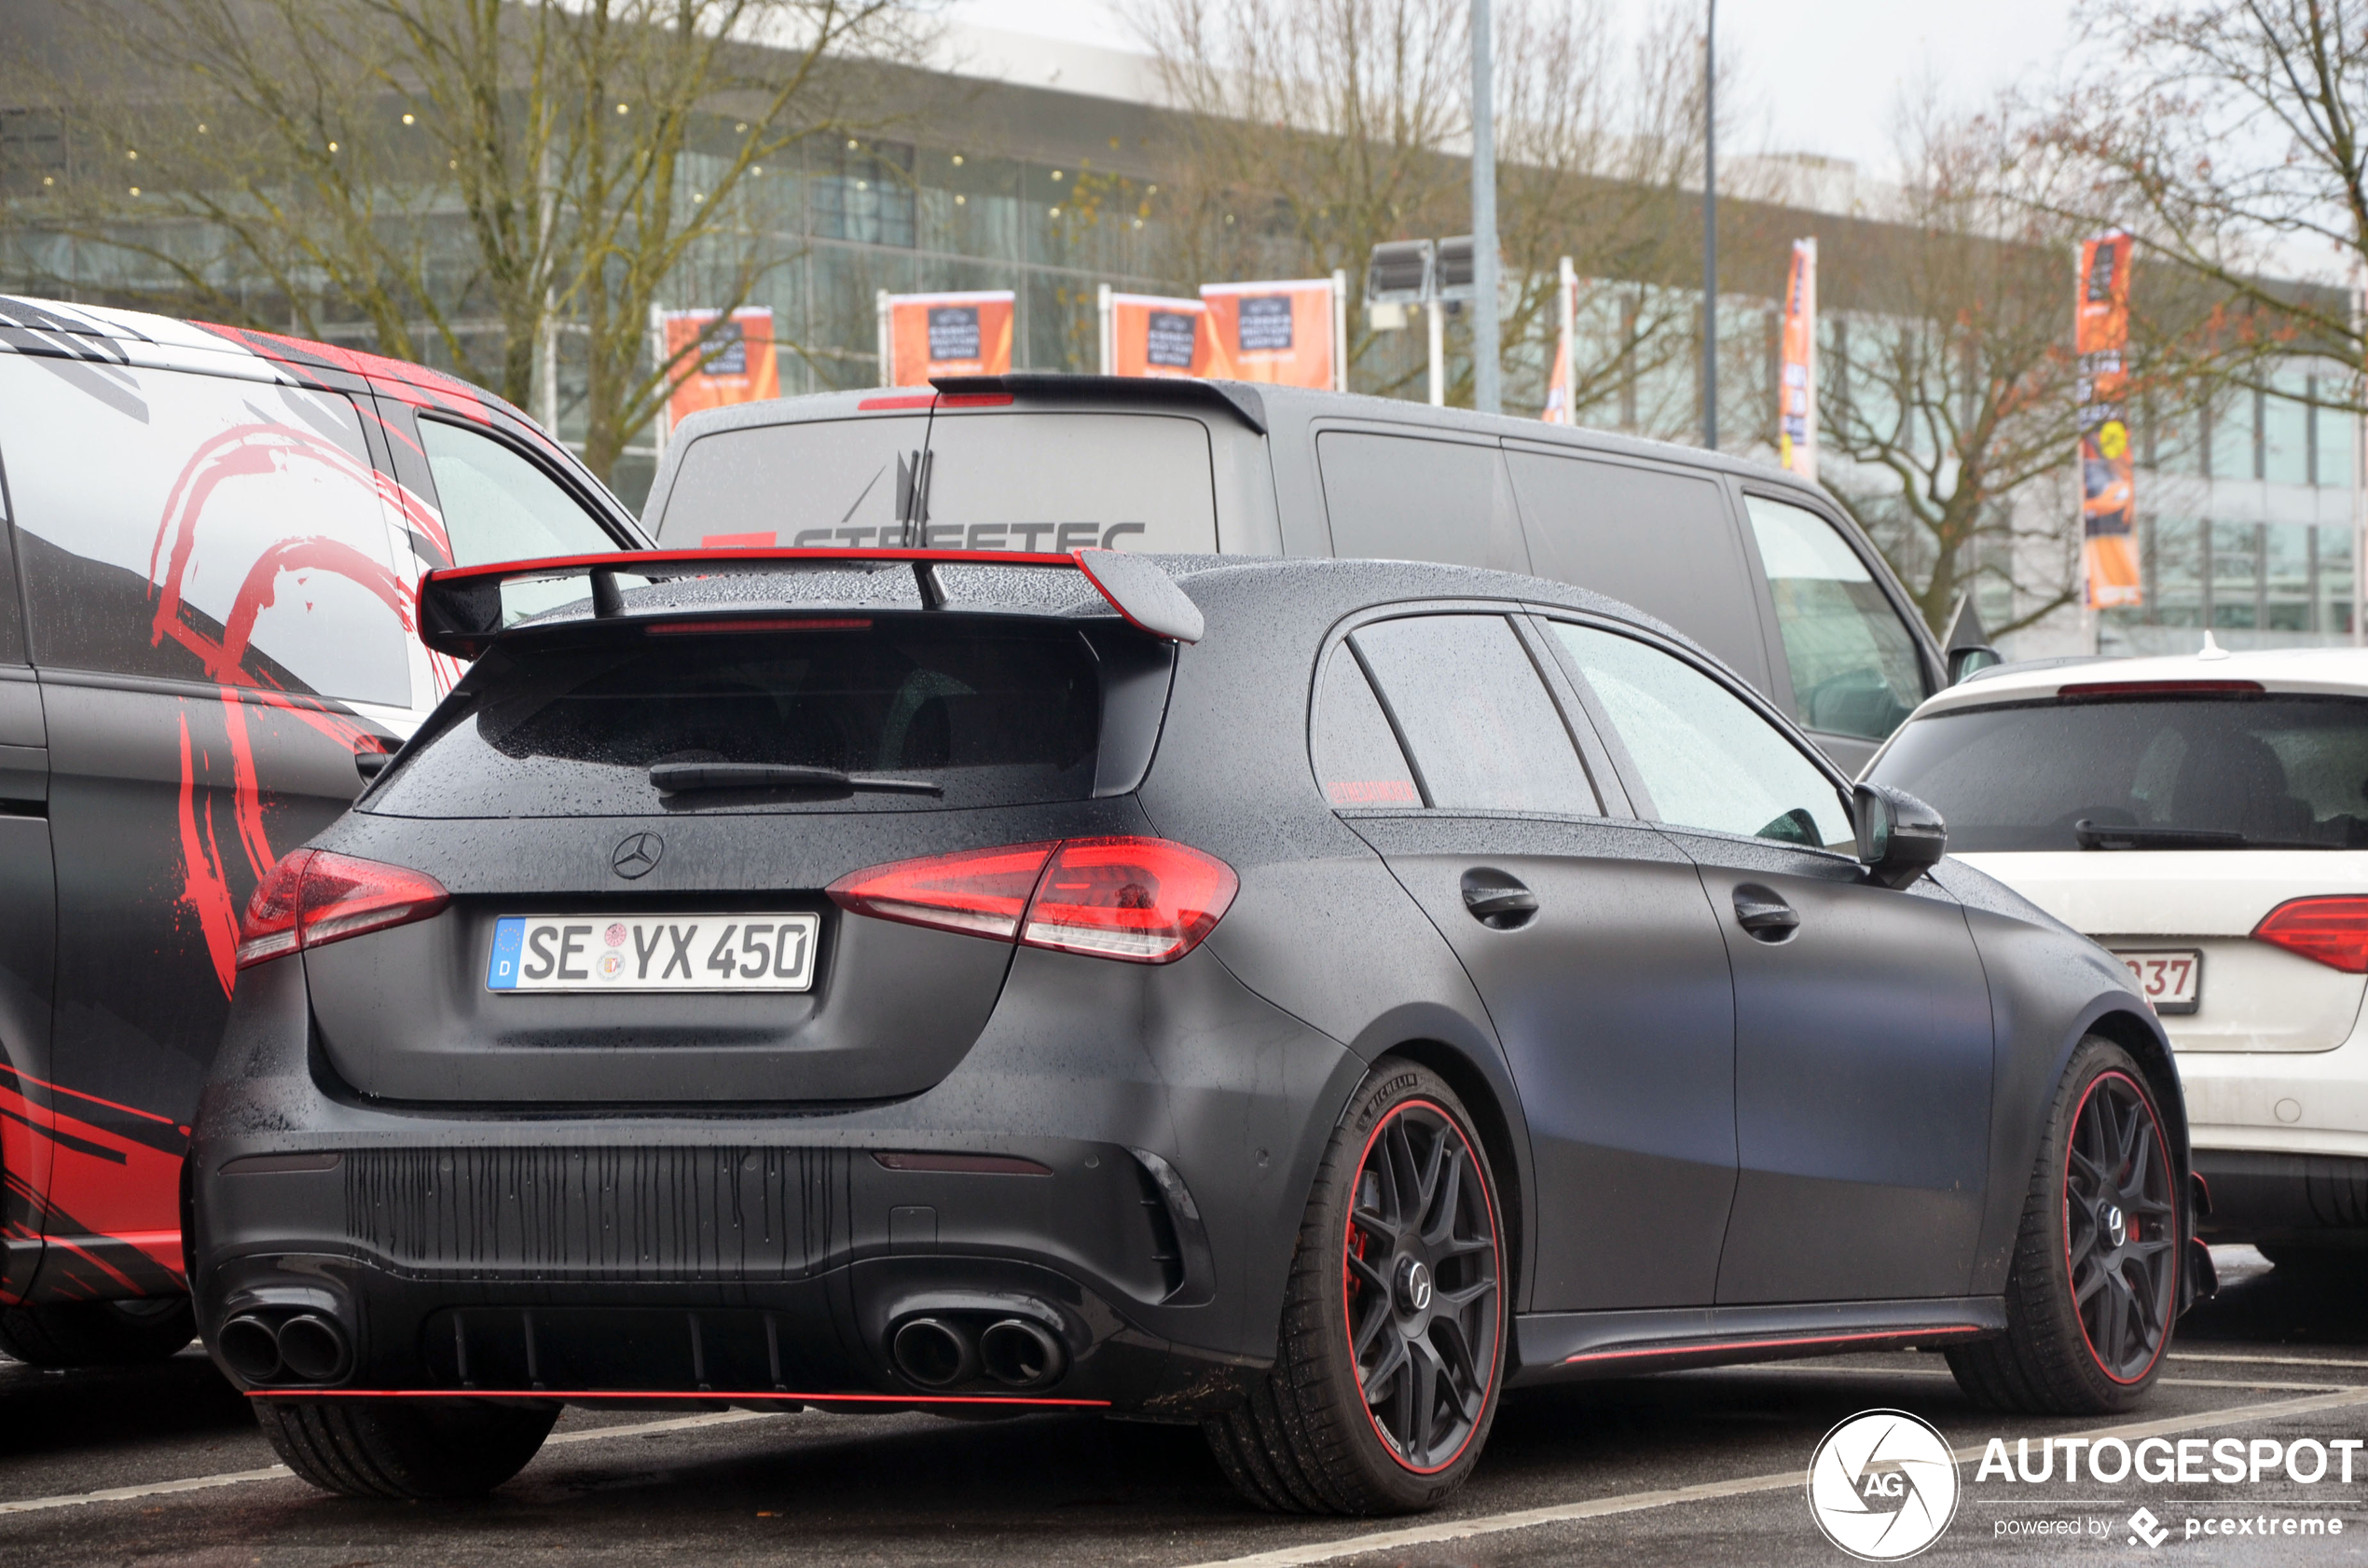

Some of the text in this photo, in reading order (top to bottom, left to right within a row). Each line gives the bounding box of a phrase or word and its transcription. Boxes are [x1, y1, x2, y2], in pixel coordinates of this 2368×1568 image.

[498, 960, 511, 977] D
[524, 924, 807, 980] SE YX 450
[1368, 1074, 1416, 1115] MICHELIN
